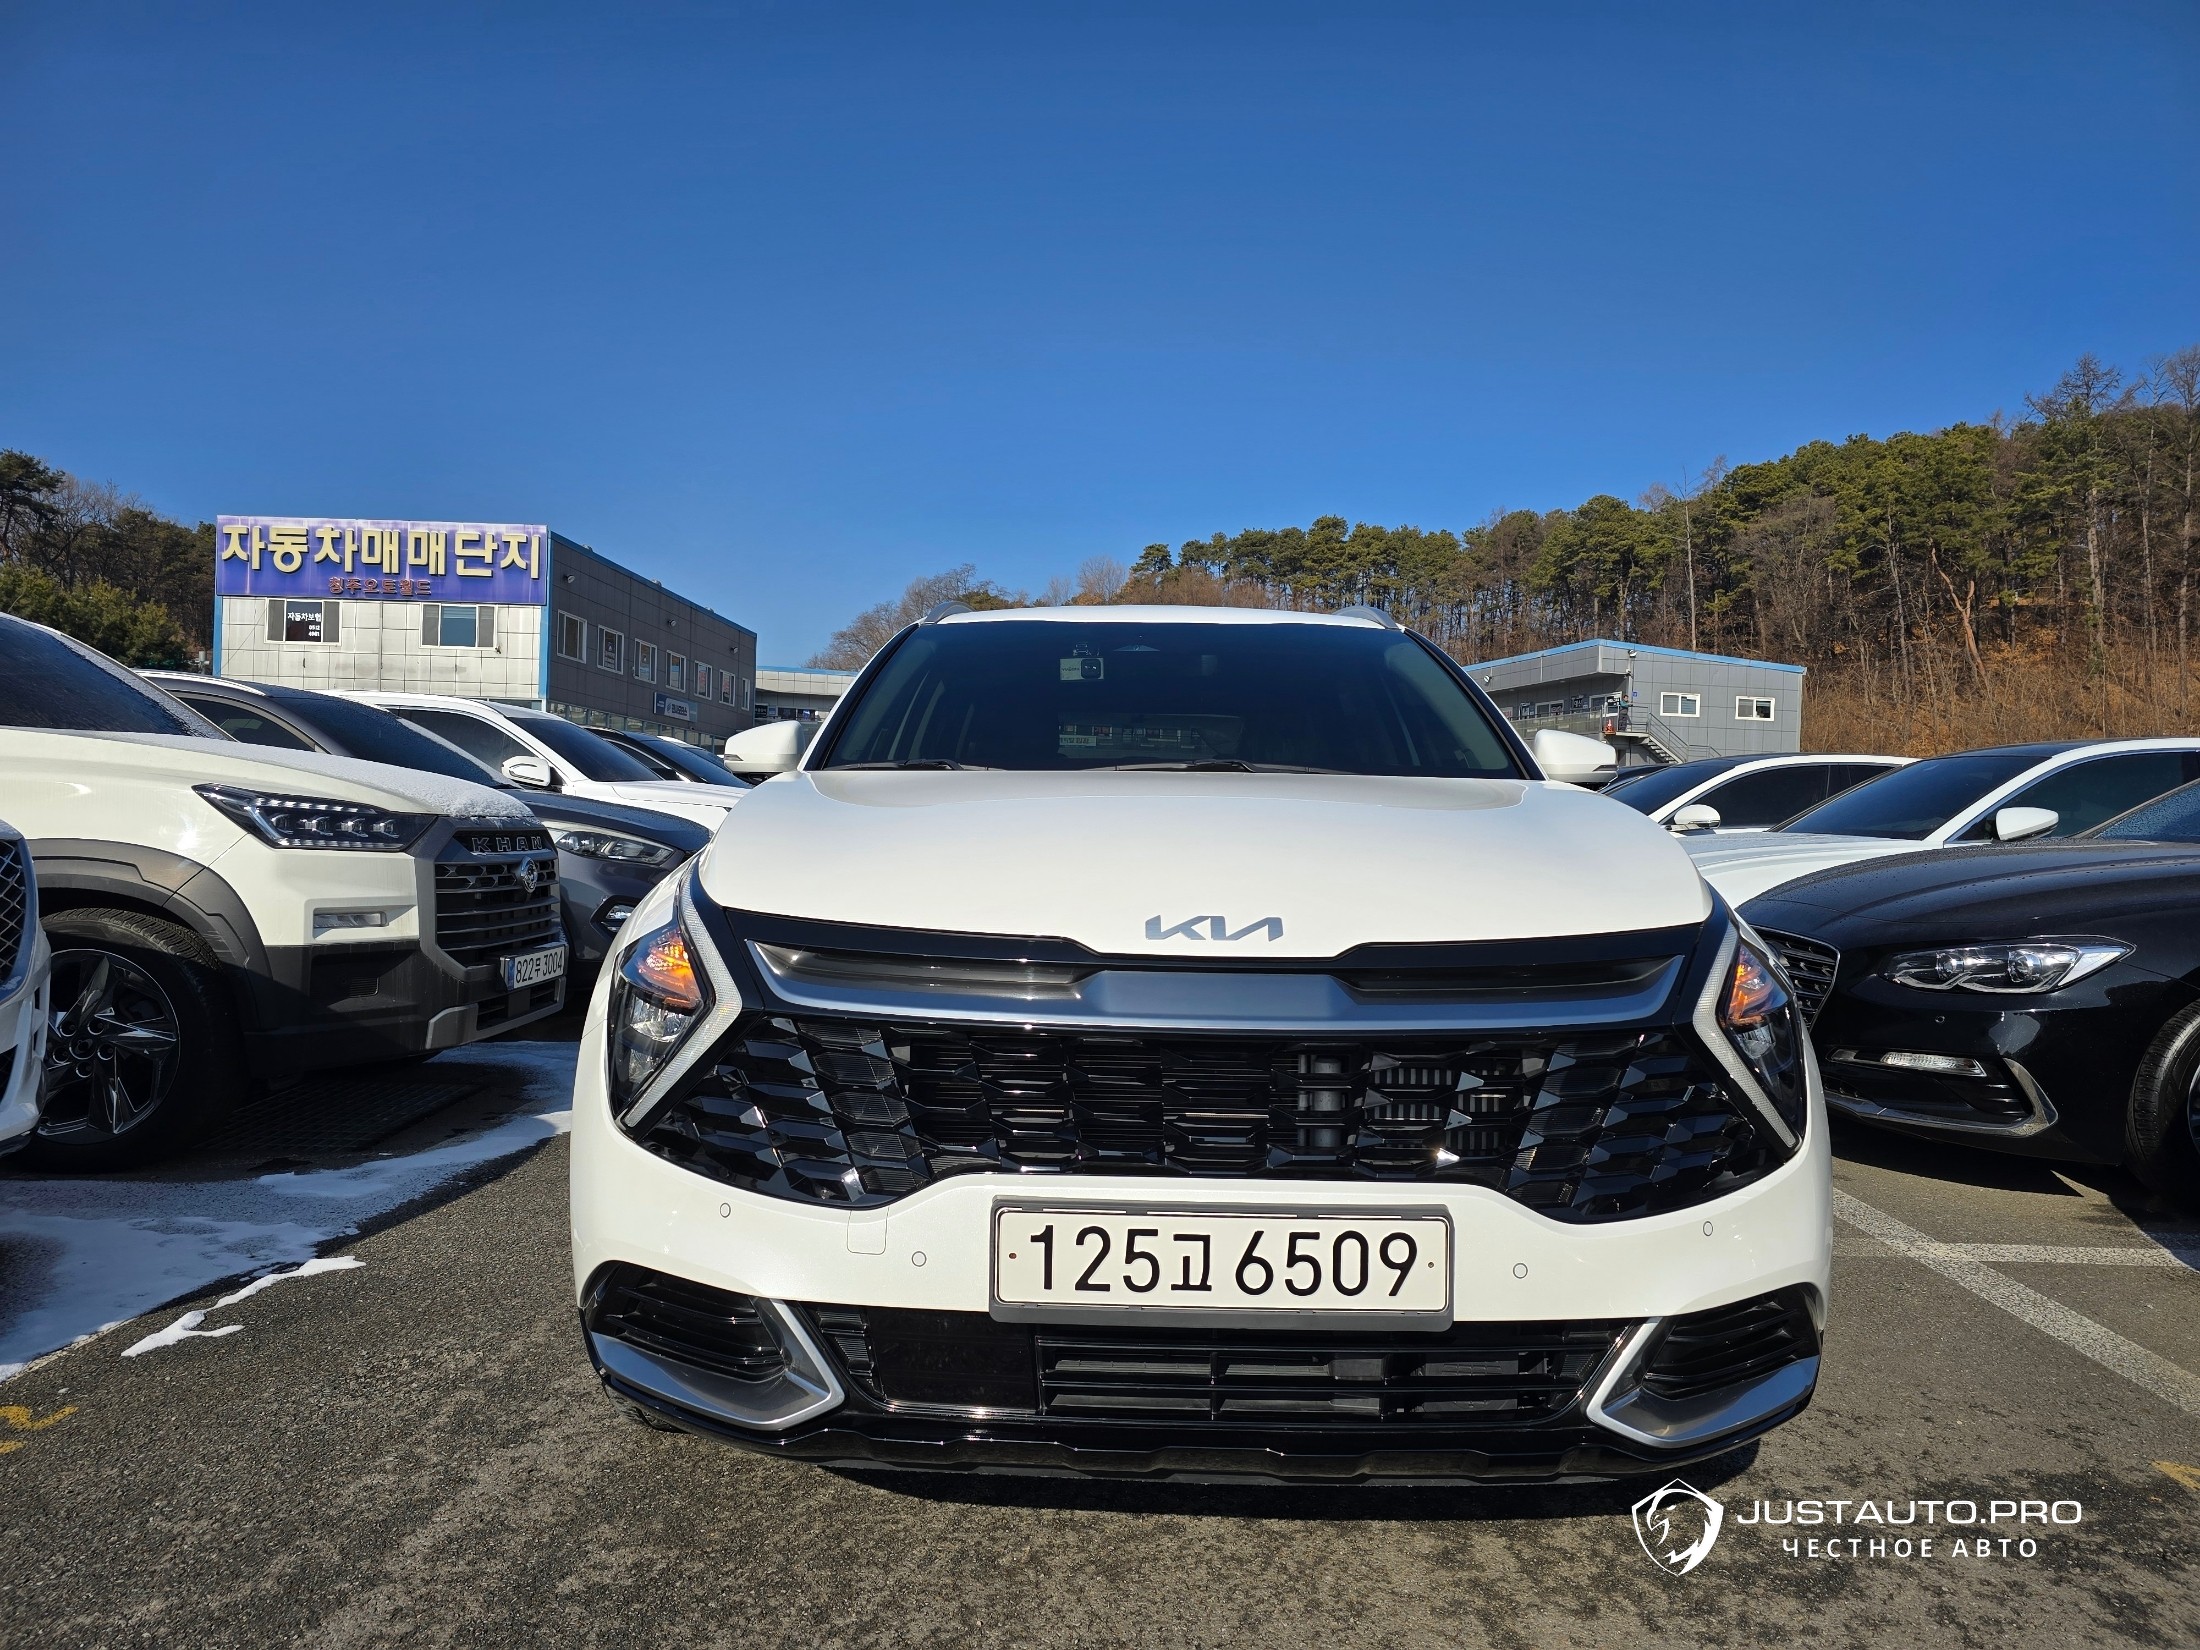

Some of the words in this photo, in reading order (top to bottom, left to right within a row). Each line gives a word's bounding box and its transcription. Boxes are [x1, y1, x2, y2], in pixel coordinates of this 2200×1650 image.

[221, 526, 541, 579] 자동차매매단지
[472, 836, 543, 852] KHAN
[543, 950, 562, 976] 3004
[1030, 1224, 1212, 1292] 125고
[1235, 1230, 1418, 1297] 6509
